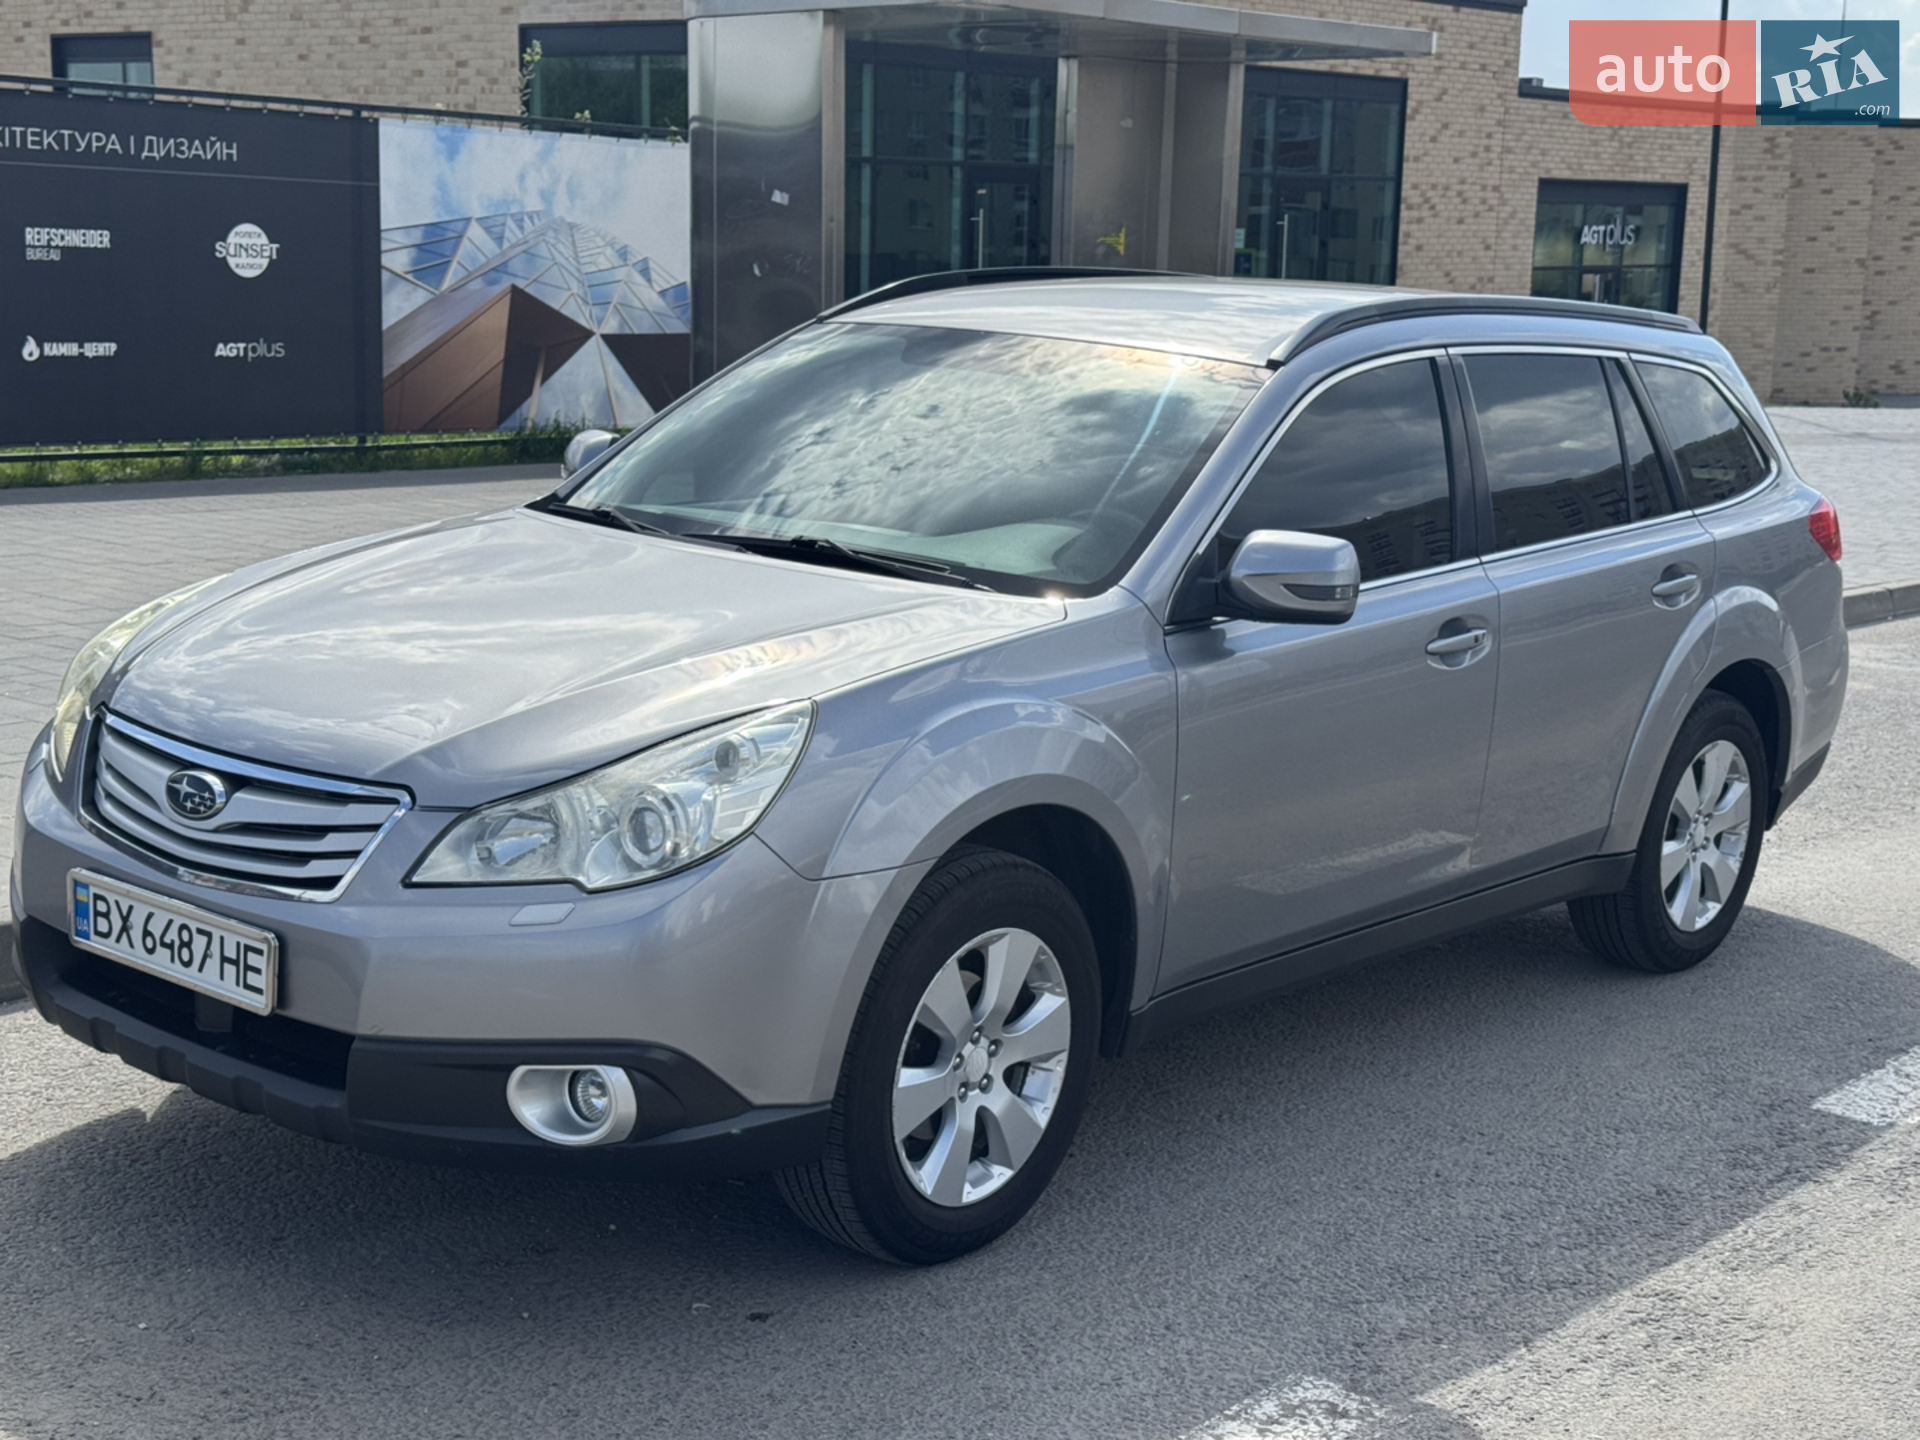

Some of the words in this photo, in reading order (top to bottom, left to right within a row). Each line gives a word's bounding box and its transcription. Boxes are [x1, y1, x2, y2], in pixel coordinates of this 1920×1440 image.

[0, 126, 123, 155] ІТЕКТУРА
[141, 135, 237, 161] ДИЗАЙН
[25, 227, 111, 248] REIFSCHNEIDER
[26, 248, 61, 260] BUREAU
[215, 241, 280, 260] SUNSET
[76, 917, 89, 931] UA
[142, 911, 213, 974] 6487
